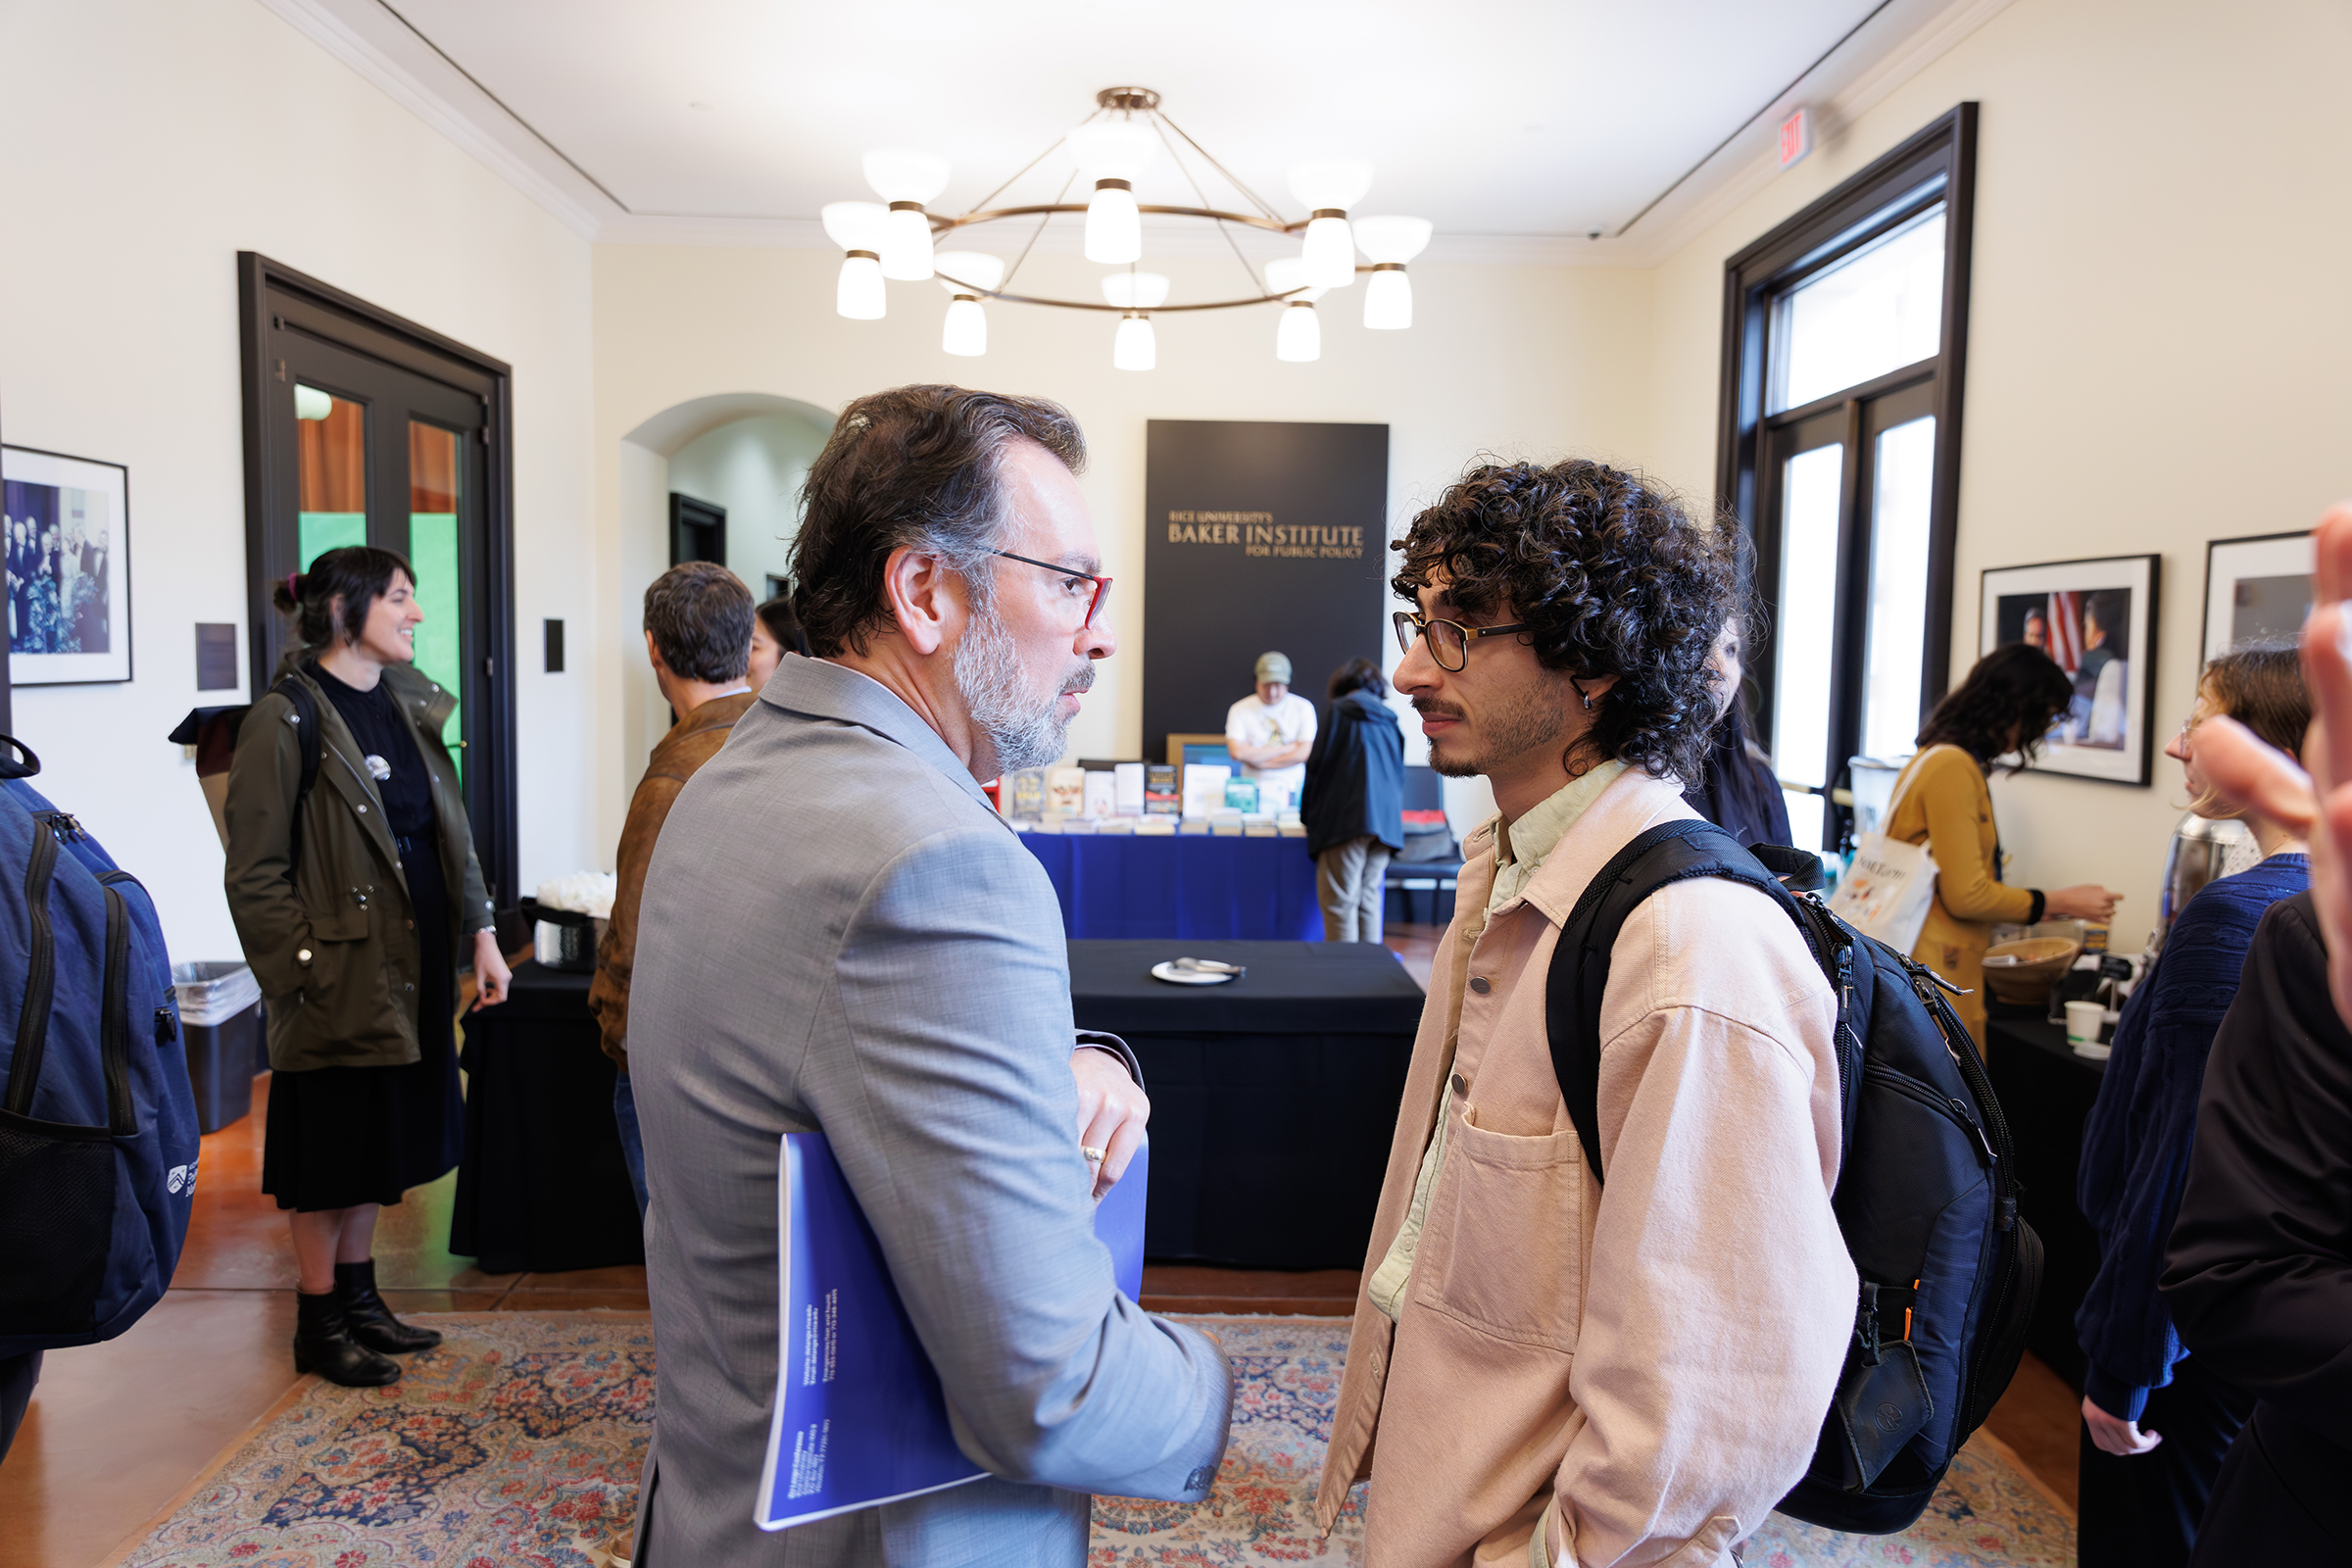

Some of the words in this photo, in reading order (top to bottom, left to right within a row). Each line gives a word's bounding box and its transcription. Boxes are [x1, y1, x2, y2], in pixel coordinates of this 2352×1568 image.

[1168, 510, 1196, 523] RICE
[1168, 522, 1240, 544] BAKER
[1246, 523, 1364, 546] INSTITUTE
[1245, 545, 1270, 558] FOR
[1272, 546, 1318, 559] PUBLIC
[1319, 546, 1364, 560] POLICY
